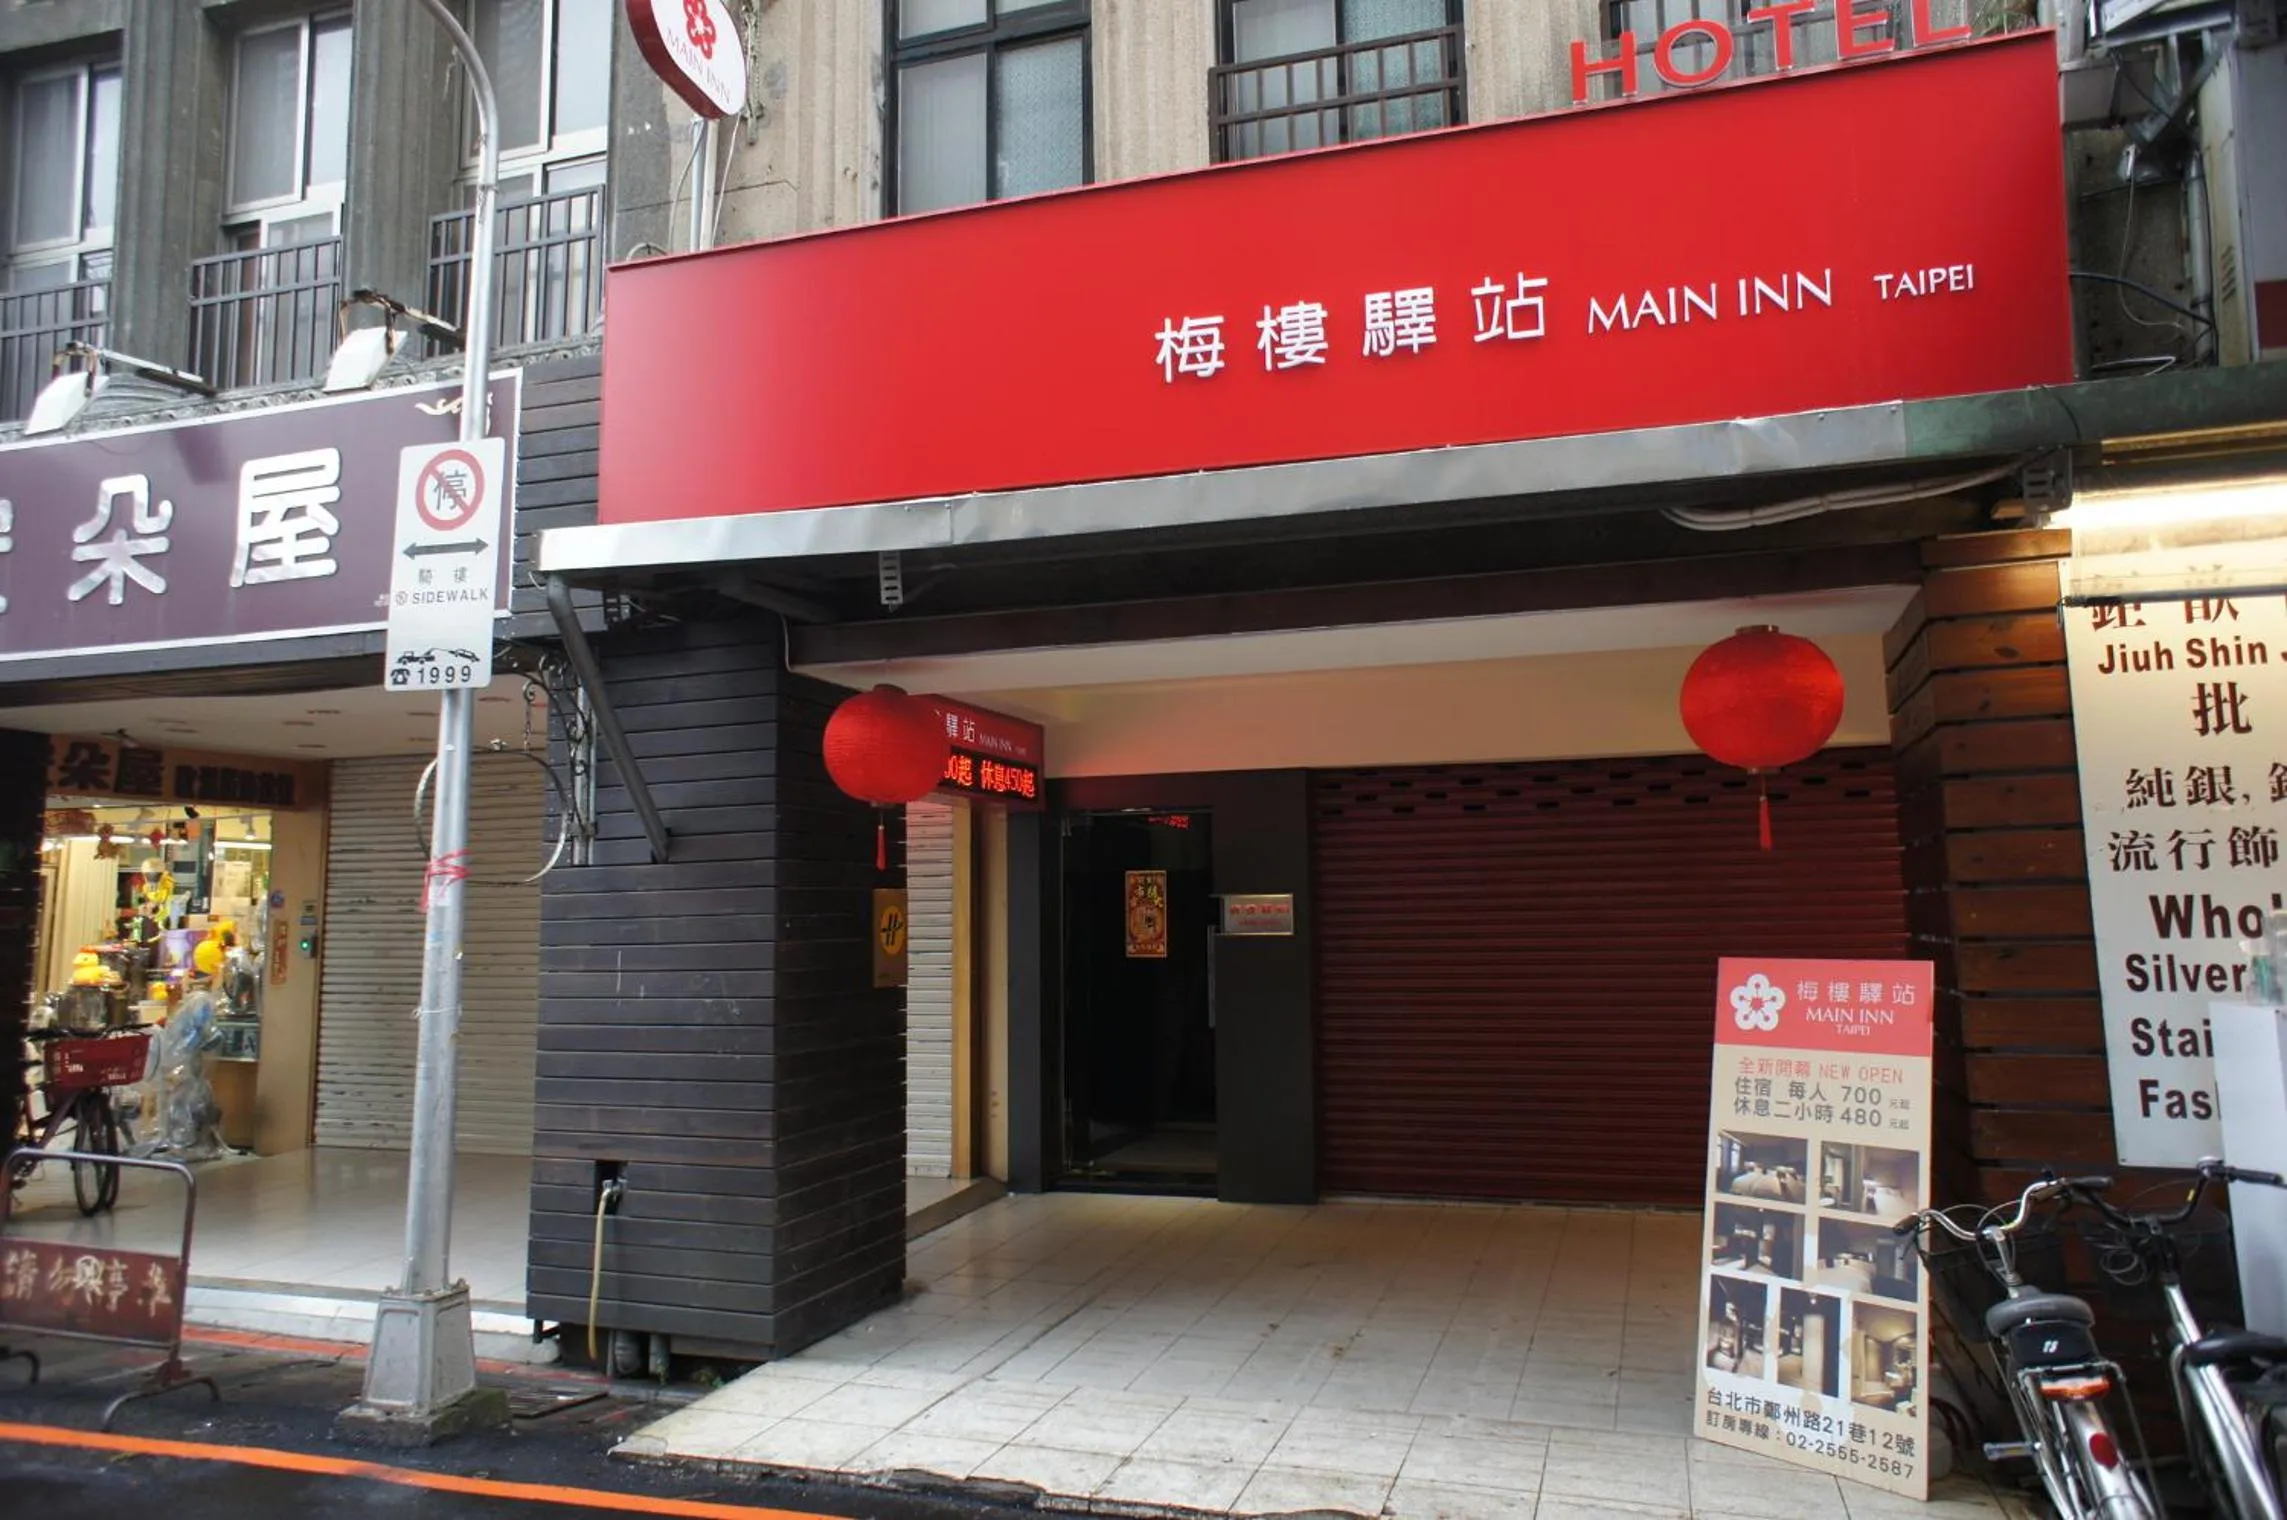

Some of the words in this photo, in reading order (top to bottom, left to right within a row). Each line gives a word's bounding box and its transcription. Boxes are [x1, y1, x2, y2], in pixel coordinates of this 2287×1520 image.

[666, 27, 703, 75] MAIN
[707, 66, 731, 104] INN
[1570, 0, 1971, 105] HOTEL
[1154, 271, 1550, 383] 梅樓驛站
[1587, 282, 1718, 334] MAIN
[1738, 267, 1833, 316] INN
[1873, 263, 1974, 300] TAIPEI
[433, 469, 467, 510] 停
[0, 447, 341, 613] 朵屋
[411, 587, 488, 605] SIDEWALK
[417, 665, 472, 684] 1999
[2098, 640, 2174, 675] Jiuh
[2186, 635, 2268, 669] Shin
[2191, 681, 2253, 736] 批
[48, 736, 163, 797] 朵屋
[2108, 825, 2279, 872] 流行飾
[2148, 892, 2283, 939] Who
[1796, 980, 1917, 1006] 梅樓驛站
[2125, 953, 2247, 993] Silver
[1805, 1007, 1854, 1023] MAIN
[1859, 1008, 1894, 1025] INN
[1835, 1024, 1871, 1036] TAIPEI
[2130, 1017, 2214, 1058] Stai
[1738, 1056, 1812, 1079] 全新開幕
[1819, 1062, 1850, 1080] NEW
[1858, 1066, 1904, 1084] OPEN
[1734, 1076, 1772, 1098] 住宿
[1788, 1081, 1828, 1103] 每人
[1840, 1085, 1882, 1106] 700
[2138, 1079, 2221, 1121] Fas
